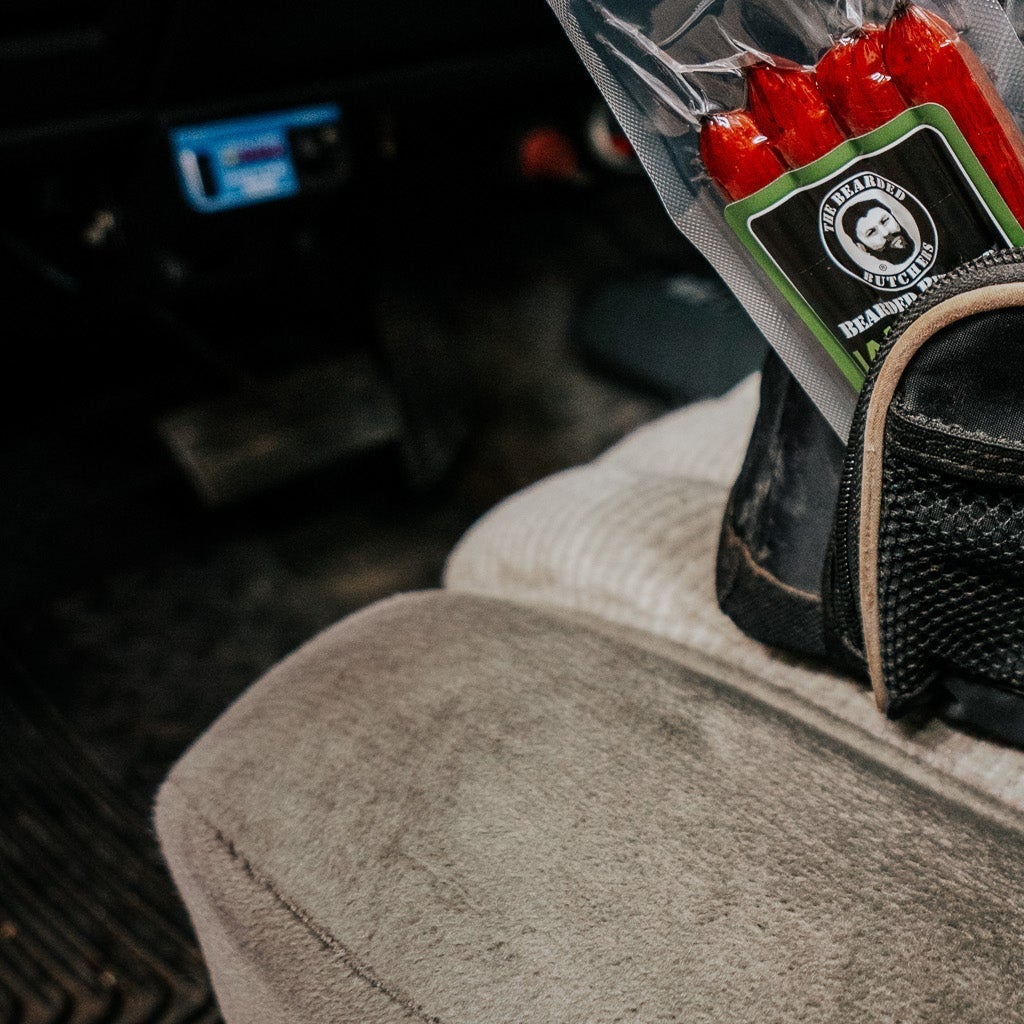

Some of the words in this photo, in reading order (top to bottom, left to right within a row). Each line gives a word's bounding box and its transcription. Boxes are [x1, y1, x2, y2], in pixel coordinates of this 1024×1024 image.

[822, 204, 837, 234] THE
[831, 174, 907, 207] BEARDED
[863, 241, 935, 289] BUTCHERS
[838, 292, 918, 339] BEARDED
